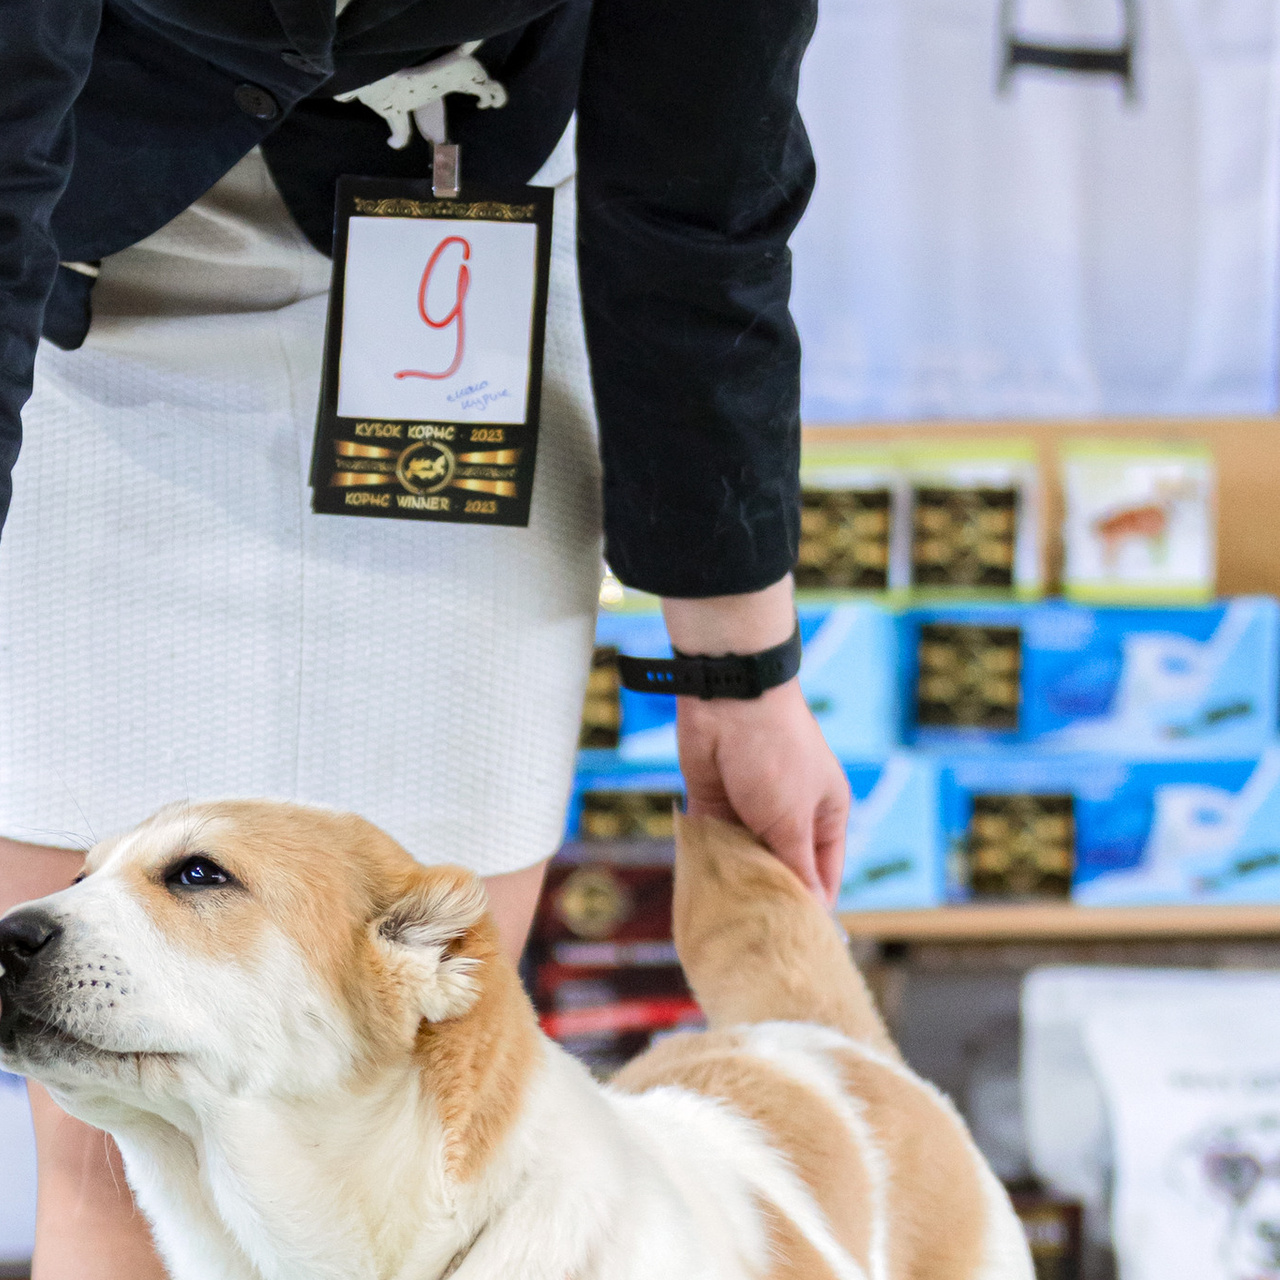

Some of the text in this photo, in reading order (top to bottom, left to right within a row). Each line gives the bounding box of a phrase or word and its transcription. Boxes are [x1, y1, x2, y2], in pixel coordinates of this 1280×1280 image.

[355, 423, 402, 438] КУБОК
[470, 428, 504, 442] 2023
[396, 495, 451, 511] WINNER
[464, 500, 498, 514] 2023
